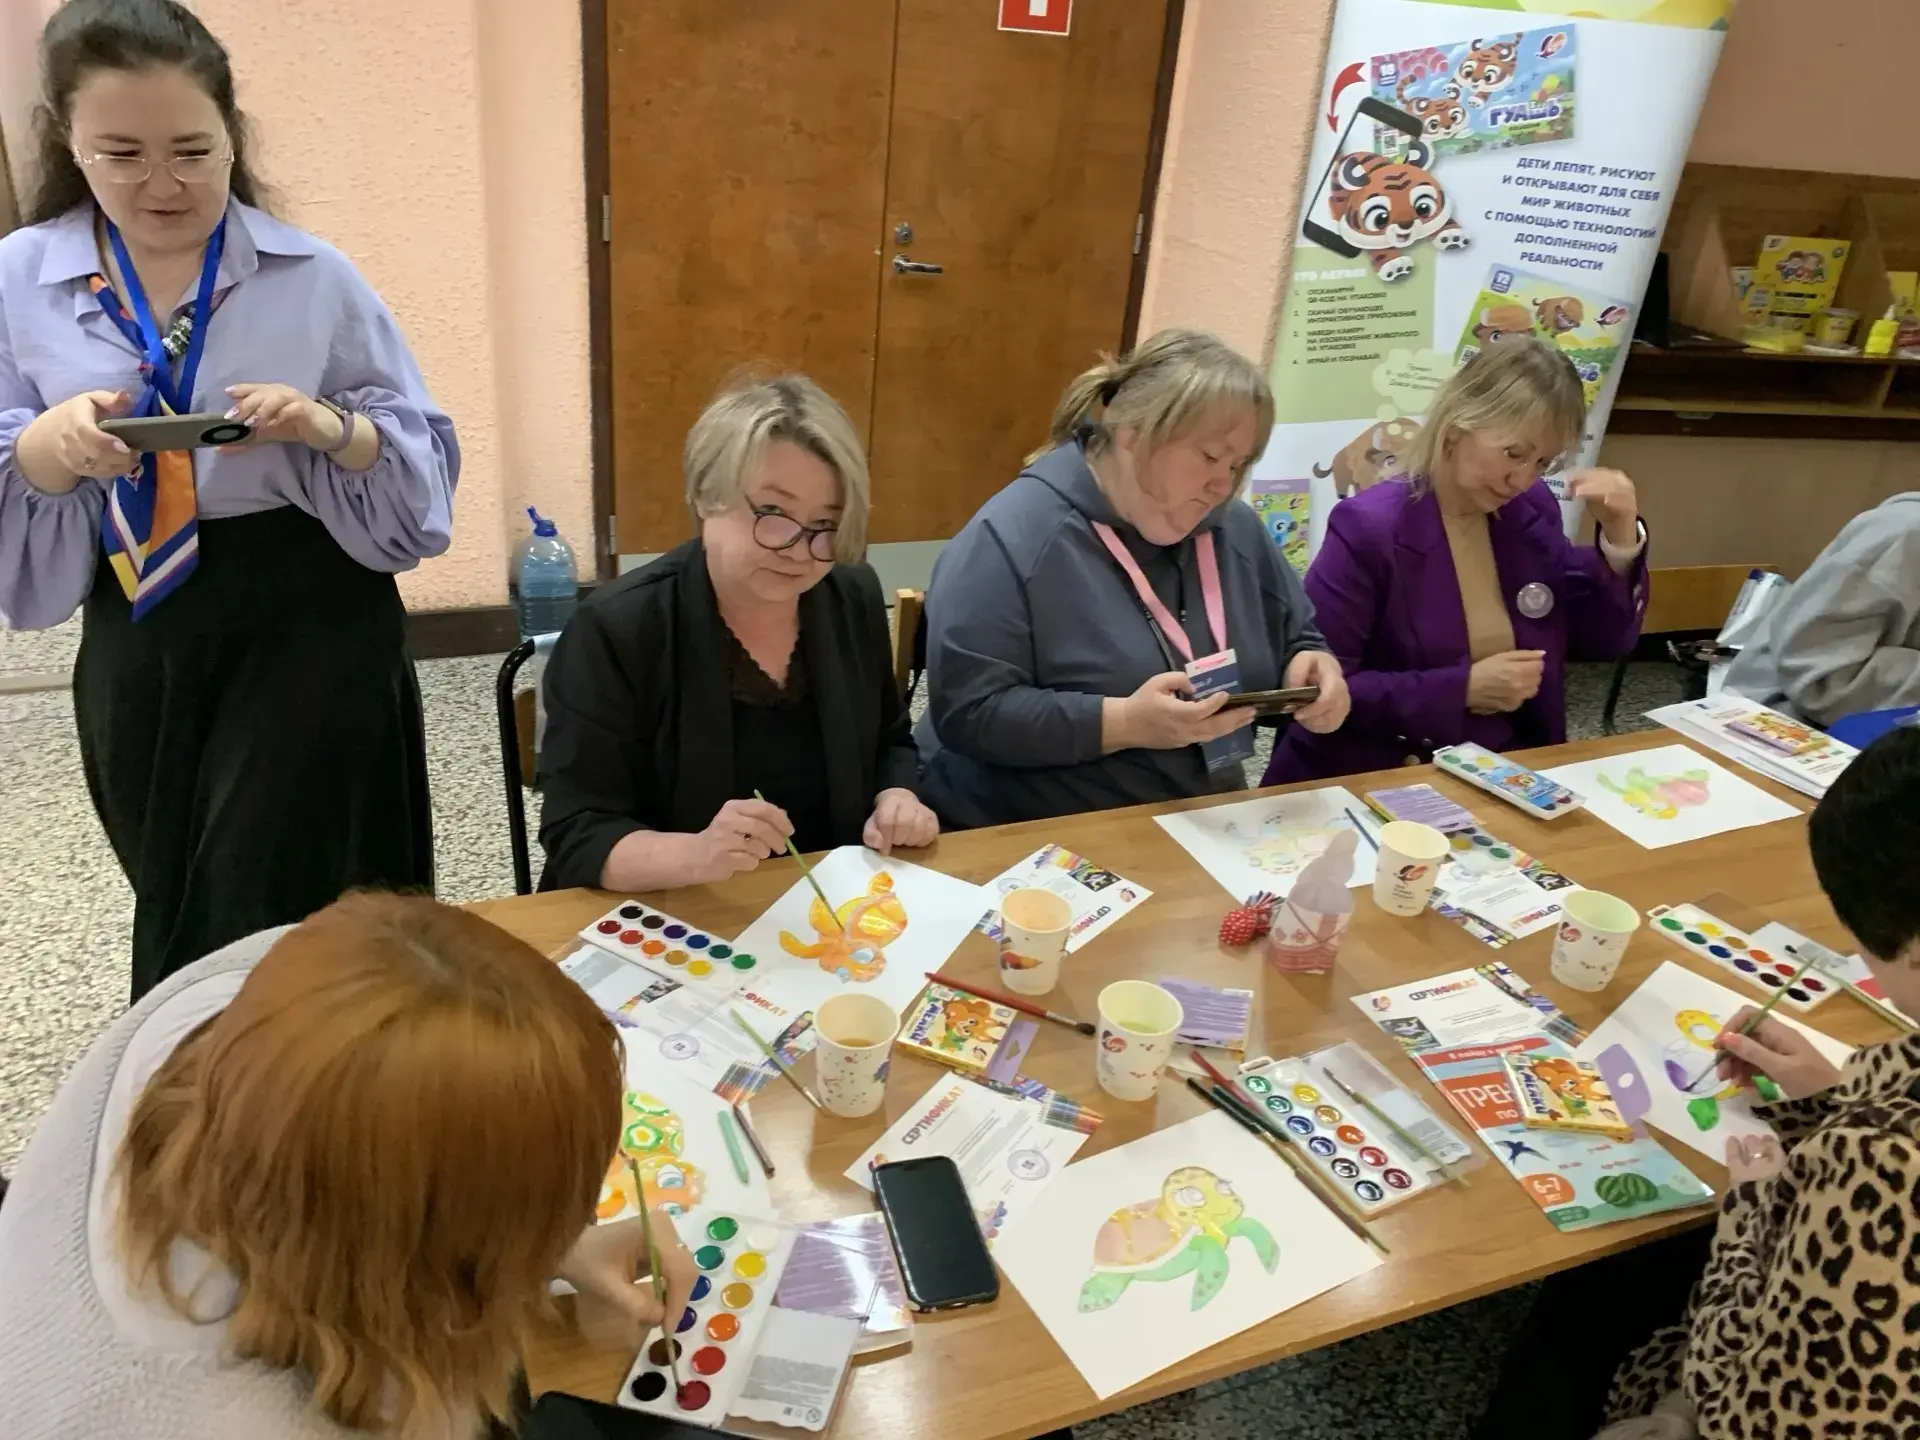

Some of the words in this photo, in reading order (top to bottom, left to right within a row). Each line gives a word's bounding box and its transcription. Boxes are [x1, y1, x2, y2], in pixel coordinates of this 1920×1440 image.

[1516, 157, 1550, 170] ДЕТИ
[1552, 161, 1596, 176] ЛЕПЯТ,
[1600, 166, 1656, 182] РИСУЮТ
[1502, 174, 1513, 185] И
[1515, 176, 1597, 194] ОТКРЫВАЮТ
[1598, 186, 1628, 198] ДЛЯ
[1630, 189, 1661, 201] СЕБЯ
[1520, 195, 1551, 207] МИР
[1552, 200, 1632, 217] ЖИВОТНЫХ
[1484, 210, 1493, 220] С
[1495, 212, 1569, 229] ПОМОЩЬЮ
[1572, 220, 1657, 239] ТЕХНОЛОГИЙ
[1514, 232, 1618, 253] ДОПОЛНЕННОЙ
[1520, 252, 1604, 271] РЕАЛЬНОСТИ
[901, 1085, 965, 1145] СЕРТИФИКАТ
